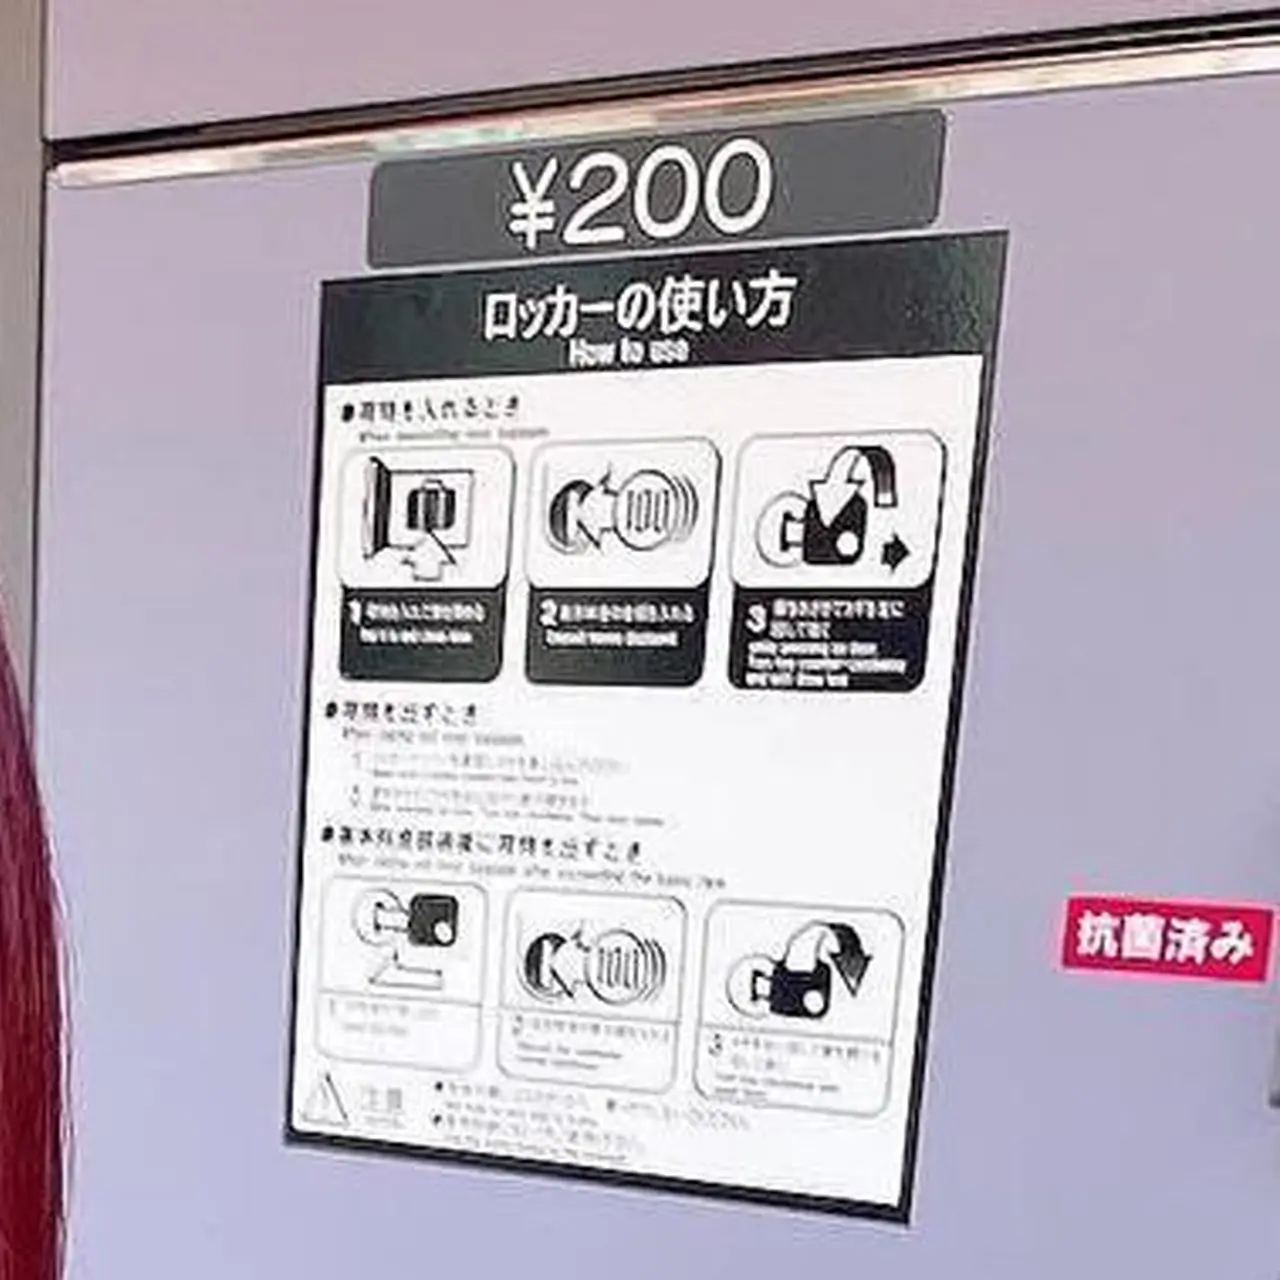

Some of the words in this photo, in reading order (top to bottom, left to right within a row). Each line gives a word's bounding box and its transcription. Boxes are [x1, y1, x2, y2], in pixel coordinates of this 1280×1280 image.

[507, 138, 774, 251] ¥200
[484, 269, 798, 341] ロッカーの使い方
[568, 338, 616, 367] How
[620, 338, 645, 364] to
[1076, 909, 1254, 966] 抗菌済み
